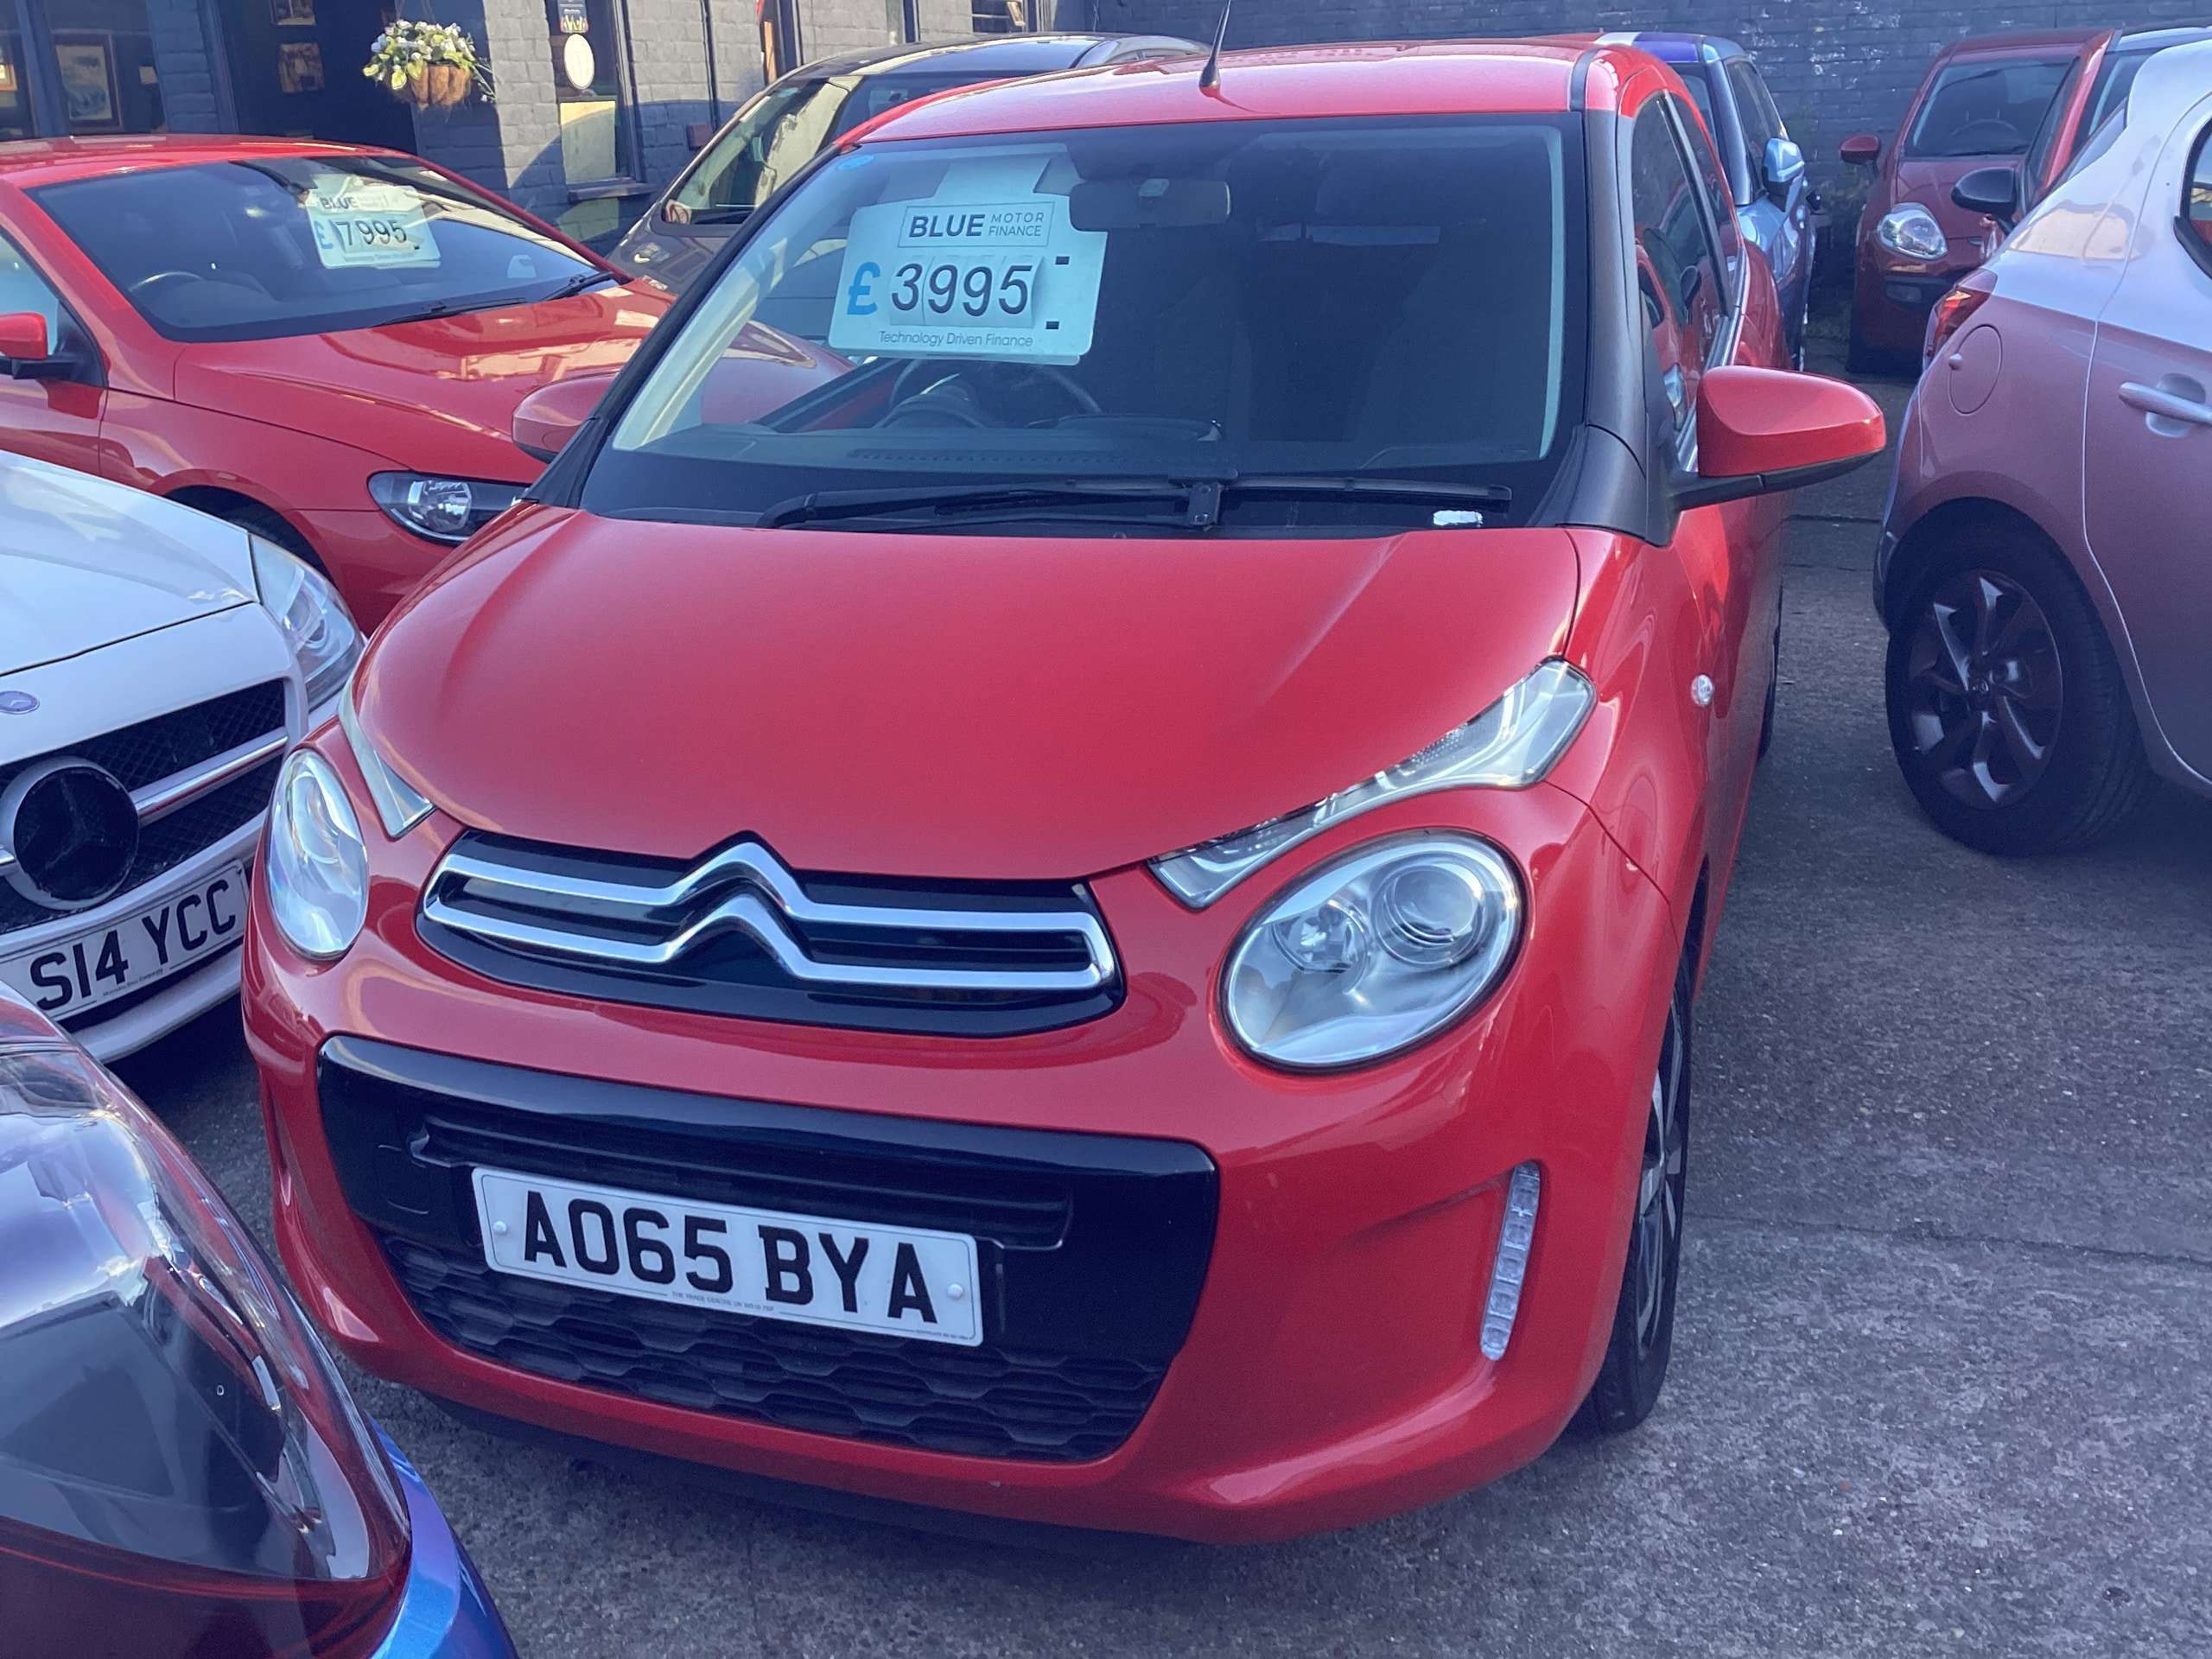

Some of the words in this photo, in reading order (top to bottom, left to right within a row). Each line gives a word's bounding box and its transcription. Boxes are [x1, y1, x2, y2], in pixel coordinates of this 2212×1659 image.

[319, 195, 359, 210] BLUE
[909, 213, 985, 238] BLUE
[989, 212, 1045, 224] MOTOR
[334, 219, 408, 246] 7995
[988, 225, 1042, 238] FINANCE
[891, 263, 1033, 317] 3995
[879, 330, 944, 347] Technology
[946, 332, 982, 346] Driven
[986, 334, 1034, 347] Finance
[29, 929, 129, 1011] S14
[142, 879, 236, 966] YCC
[524, 1190, 734, 1294] AO65
[757, 1224, 938, 1325] BYA
